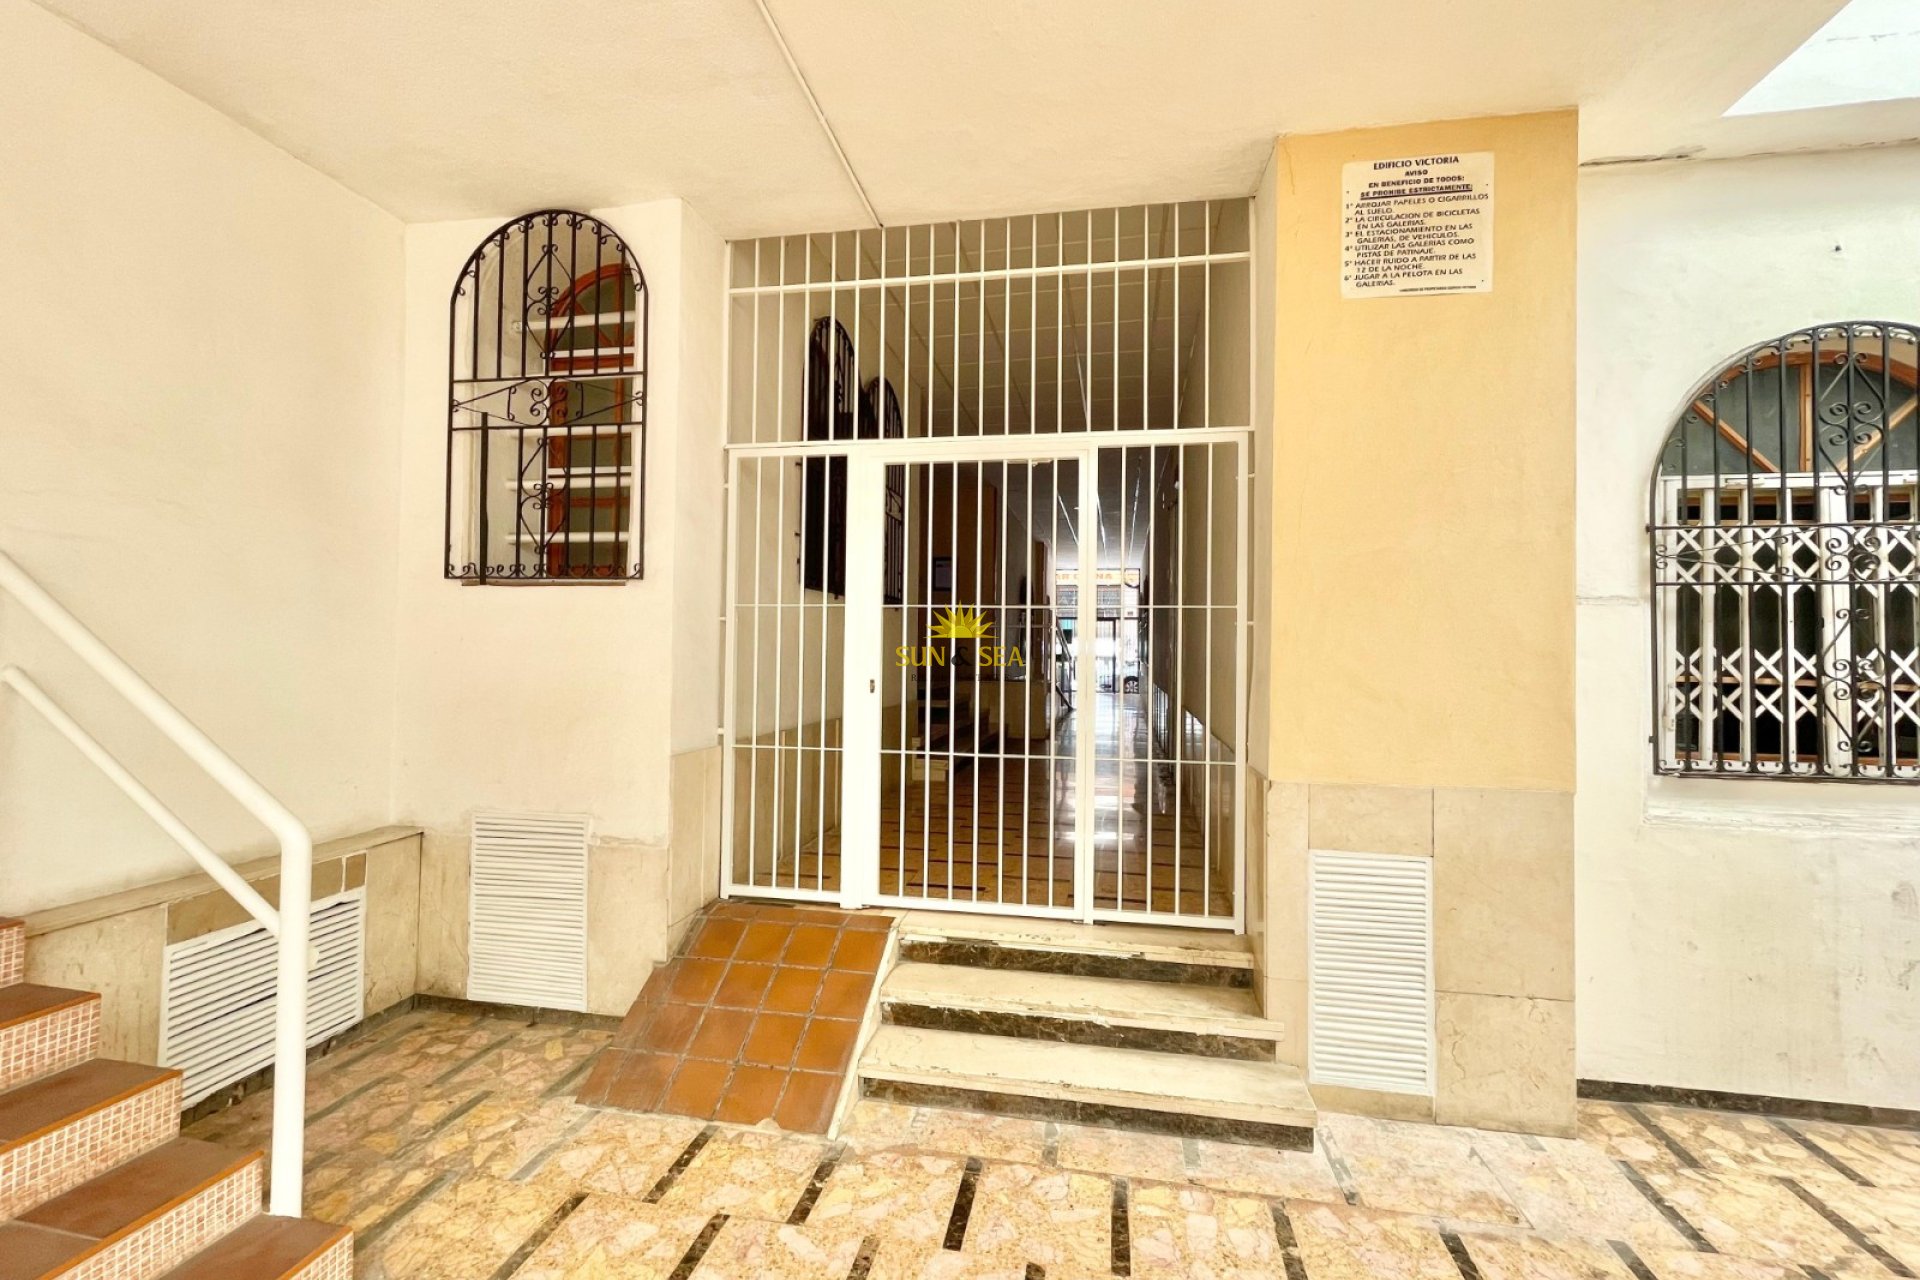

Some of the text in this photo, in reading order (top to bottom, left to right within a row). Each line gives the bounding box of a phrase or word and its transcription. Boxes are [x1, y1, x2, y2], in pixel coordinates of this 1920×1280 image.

[1374, 156, 1459, 170] EDIFICIO VICTORIA
[1381, 179, 1421, 187] BENEFICIO
[1372, 188, 1405, 196] PROHIBE
[1356, 200, 1391, 208] ARROJAR
[1438, 194, 1488, 203] CIGARRILLOS
[1367, 212, 1420, 222] CIRCULACION
[1436, 208, 1480, 217] BICICLETAS
[1367, 226, 1442, 236] ESTACIONAMIENTO
[1355, 243, 1389, 251] UTILIZAR
[1408, 239, 1446, 247] GALERIAS
[1354, 257, 1380, 266] HACER
